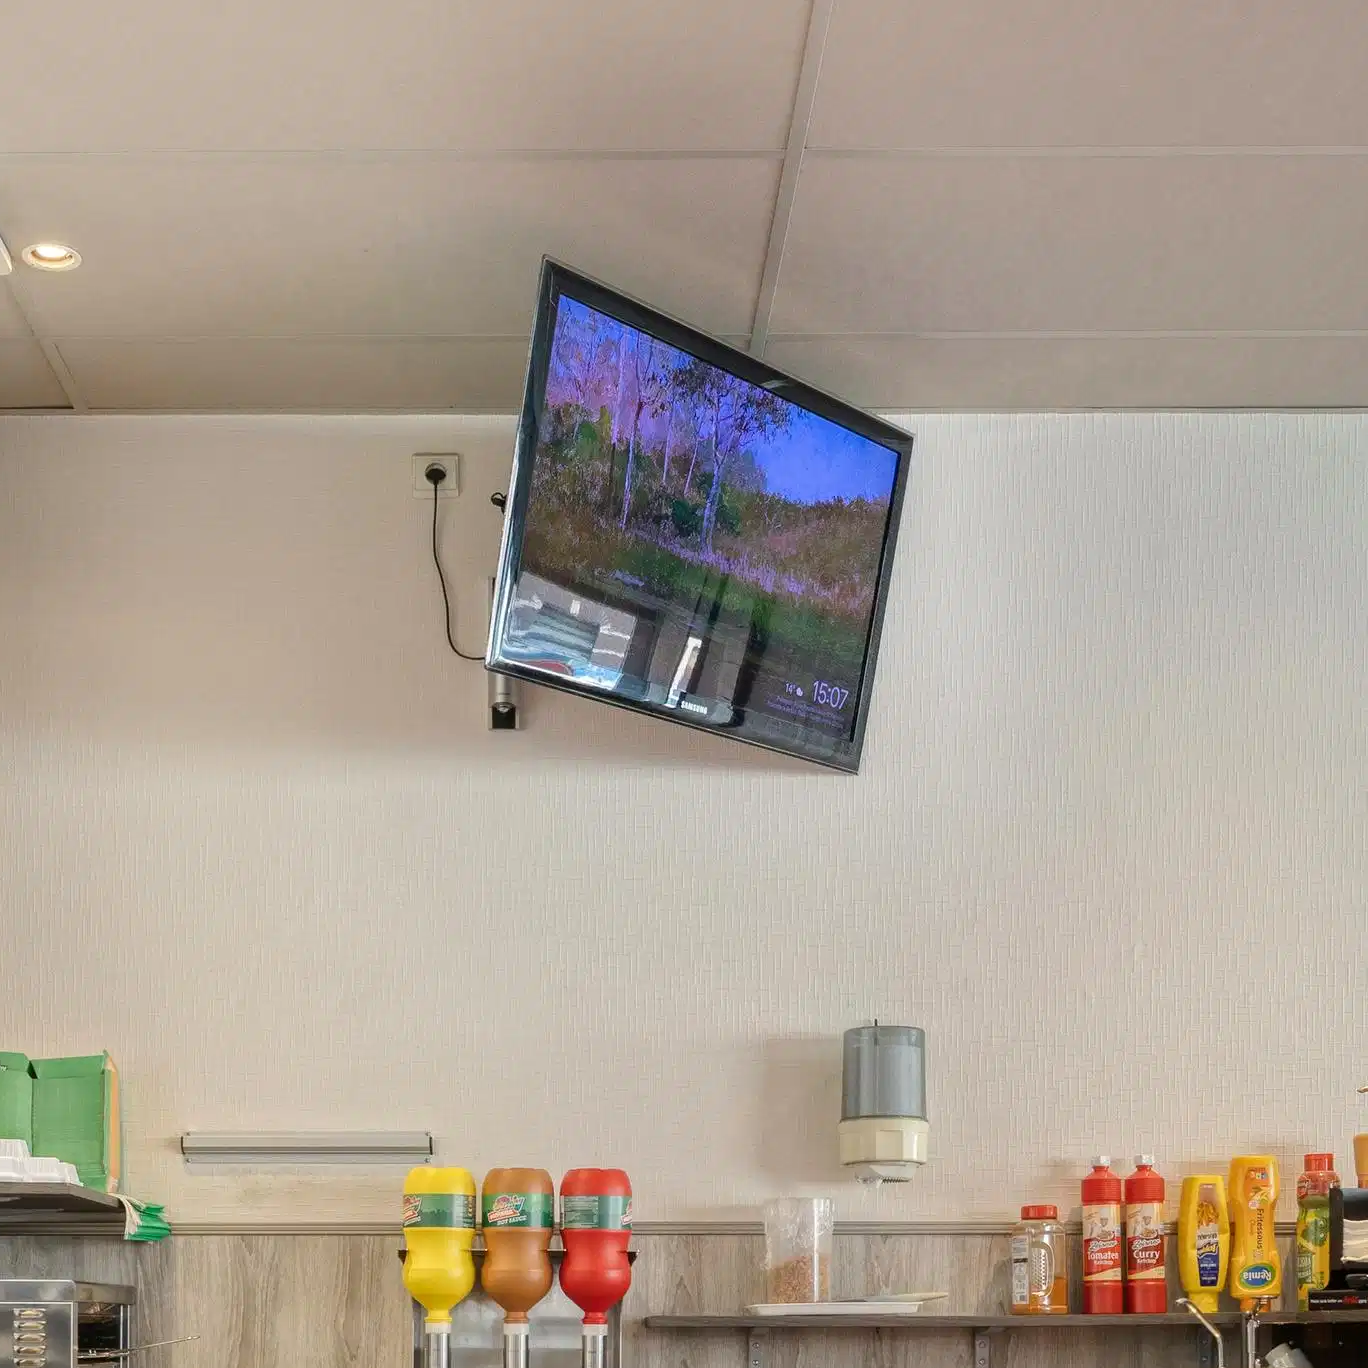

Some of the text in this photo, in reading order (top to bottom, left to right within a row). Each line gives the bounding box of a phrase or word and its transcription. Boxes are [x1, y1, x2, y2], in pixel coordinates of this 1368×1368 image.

[813, 680, 849, 710] 15:07
[680, 700, 708, 715] SAMSUNG
[1133, 1249, 1160, 1261] Curry
[1242, 1268, 1272, 1281] Remia
